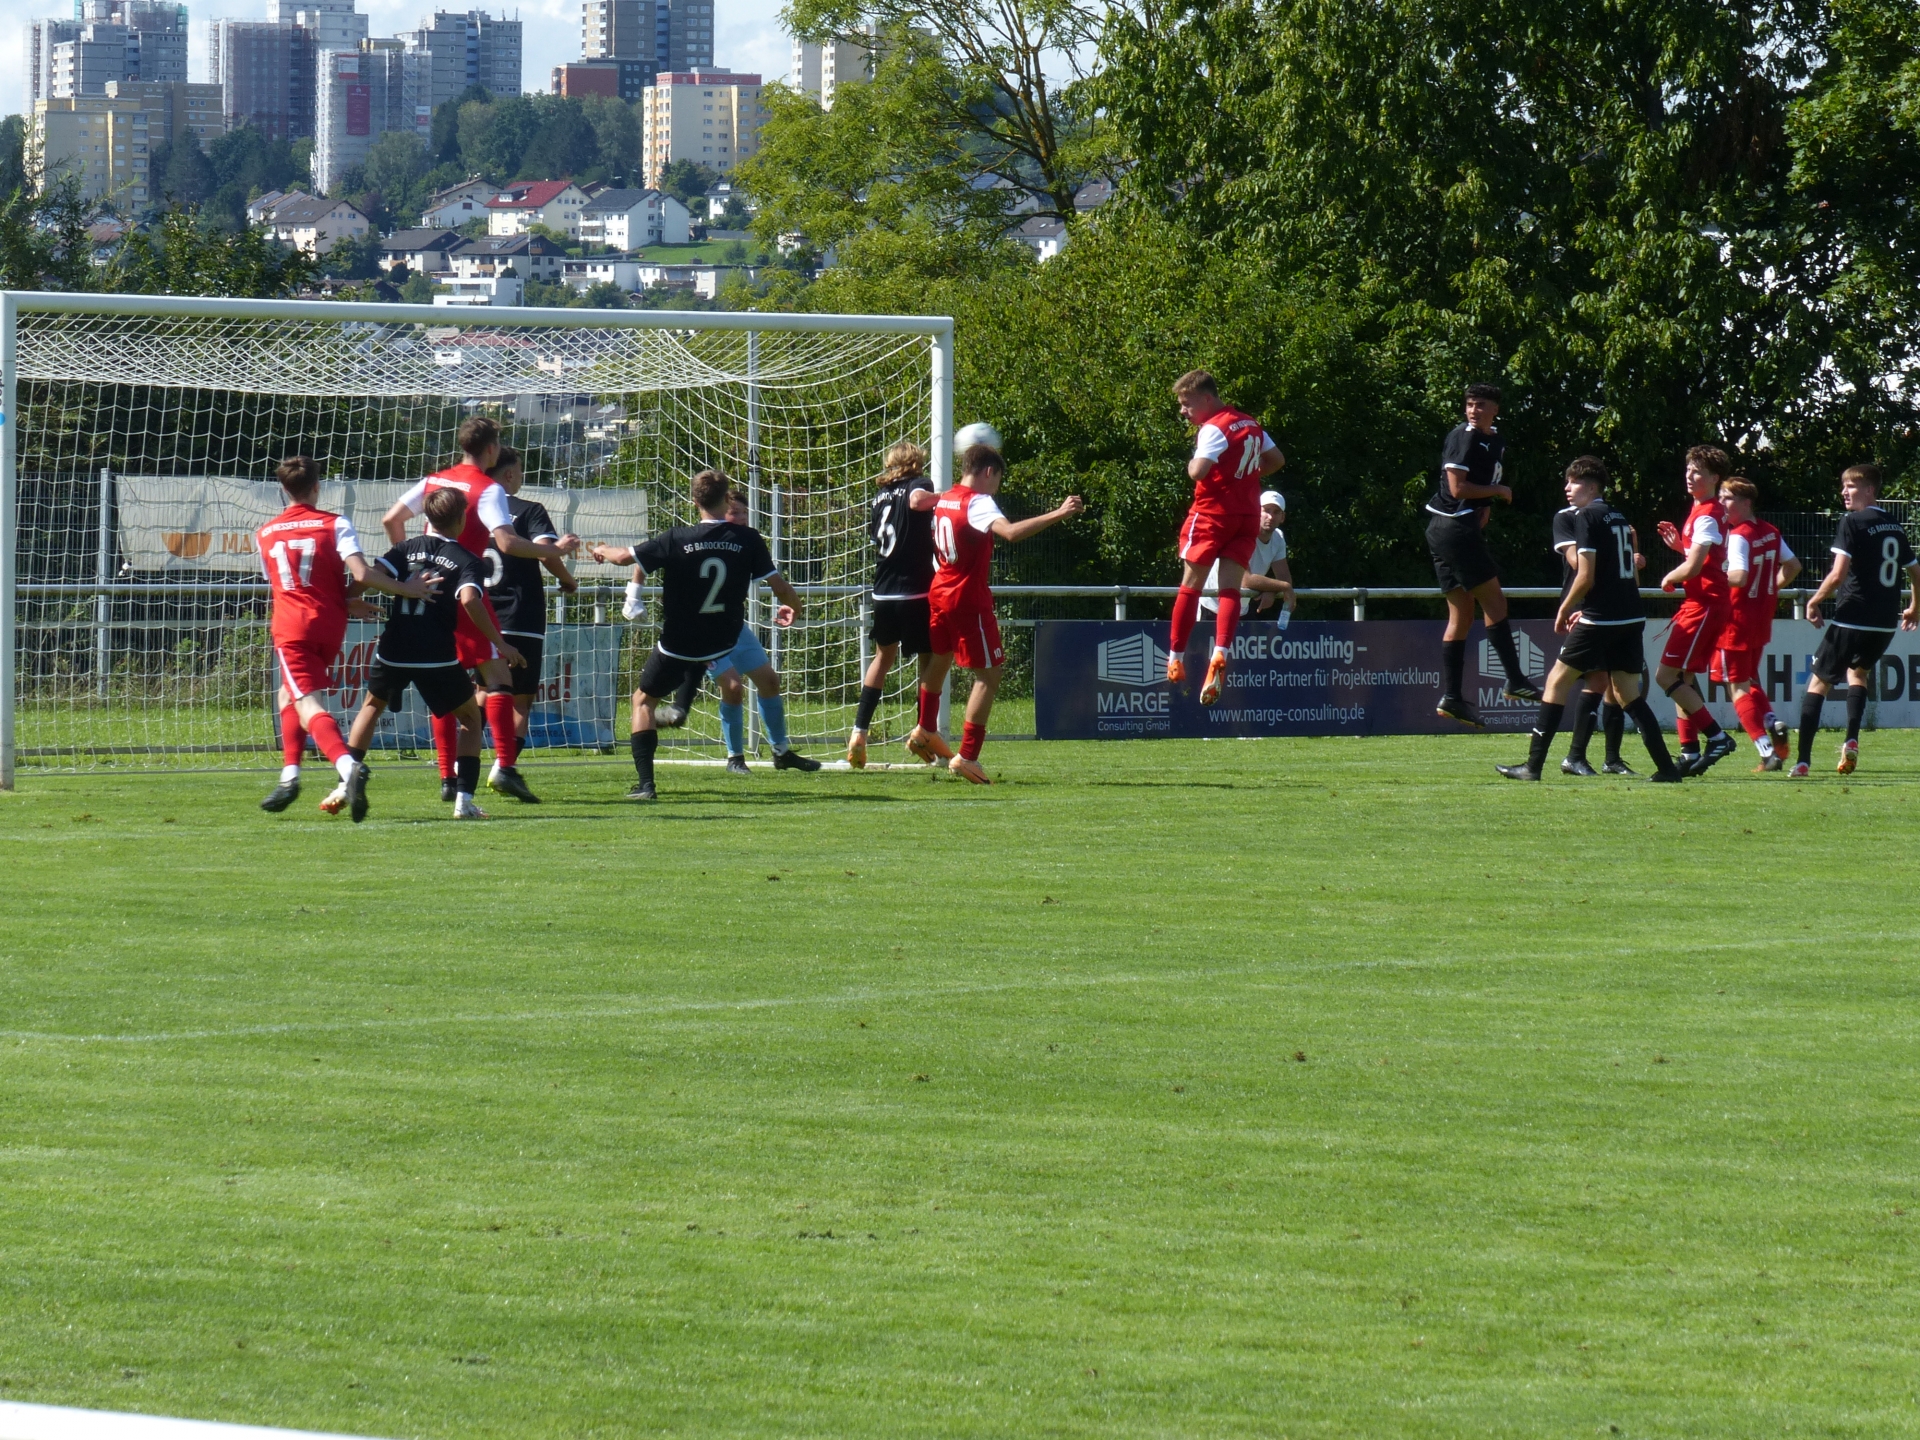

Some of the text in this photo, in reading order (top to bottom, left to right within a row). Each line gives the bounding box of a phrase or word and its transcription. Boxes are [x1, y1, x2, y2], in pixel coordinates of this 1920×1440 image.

[877, 505, 897, 558] 6
[683, 541, 743, 554] SG BAROCKSTADT
[1610, 525, 1634, 579] 15
[1879, 535, 1899, 588] 8
[268, 537, 316, 591] 17
[699, 556, 727, 614] 2
[1270, 634, 1354, 665] Consulting
[1226, 666, 1440, 690] starker Partner für Projektentwicklung
[1097, 691, 1170, 713] MARGE
[1208, 702, 1365, 727] www.marge-consulting.de
[1097, 720, 1171, 733] Consulting GmbH
